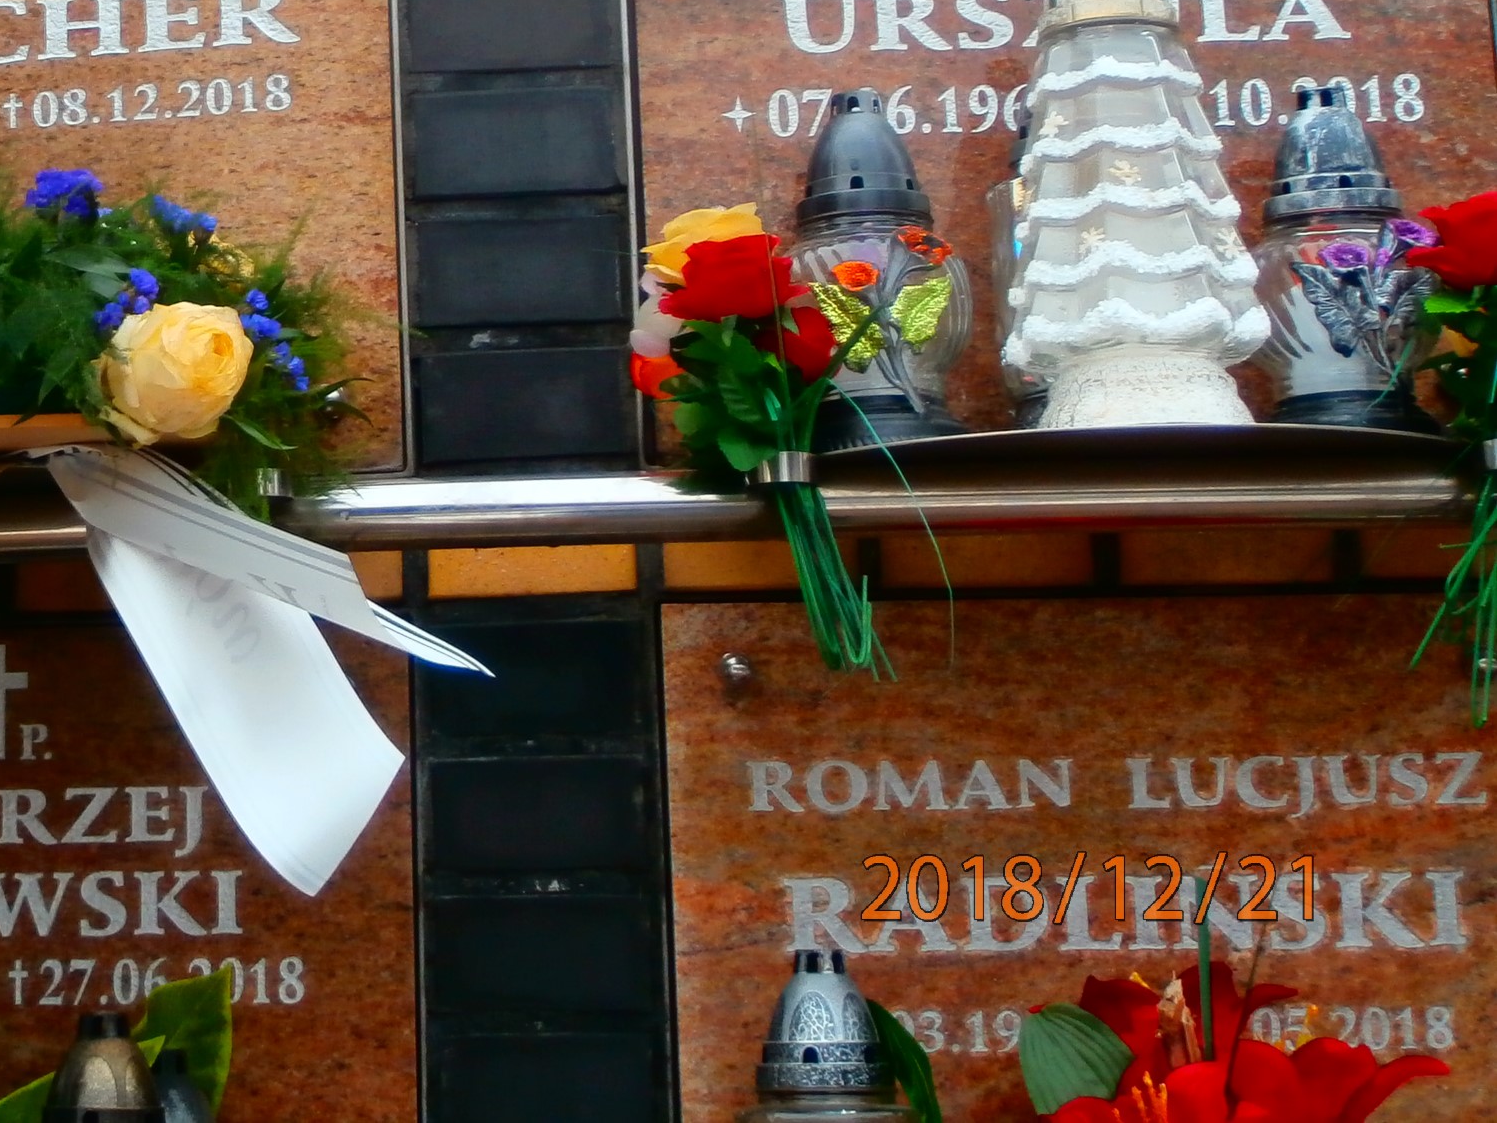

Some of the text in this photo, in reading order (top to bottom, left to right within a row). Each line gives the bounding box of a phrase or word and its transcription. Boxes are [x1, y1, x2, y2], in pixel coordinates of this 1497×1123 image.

[31, 73, 293, 129] 08.12.2018
[19, 723, 54, 761] P.
[746, 750, 1488, 821] ROMAN LUCJUSZ
